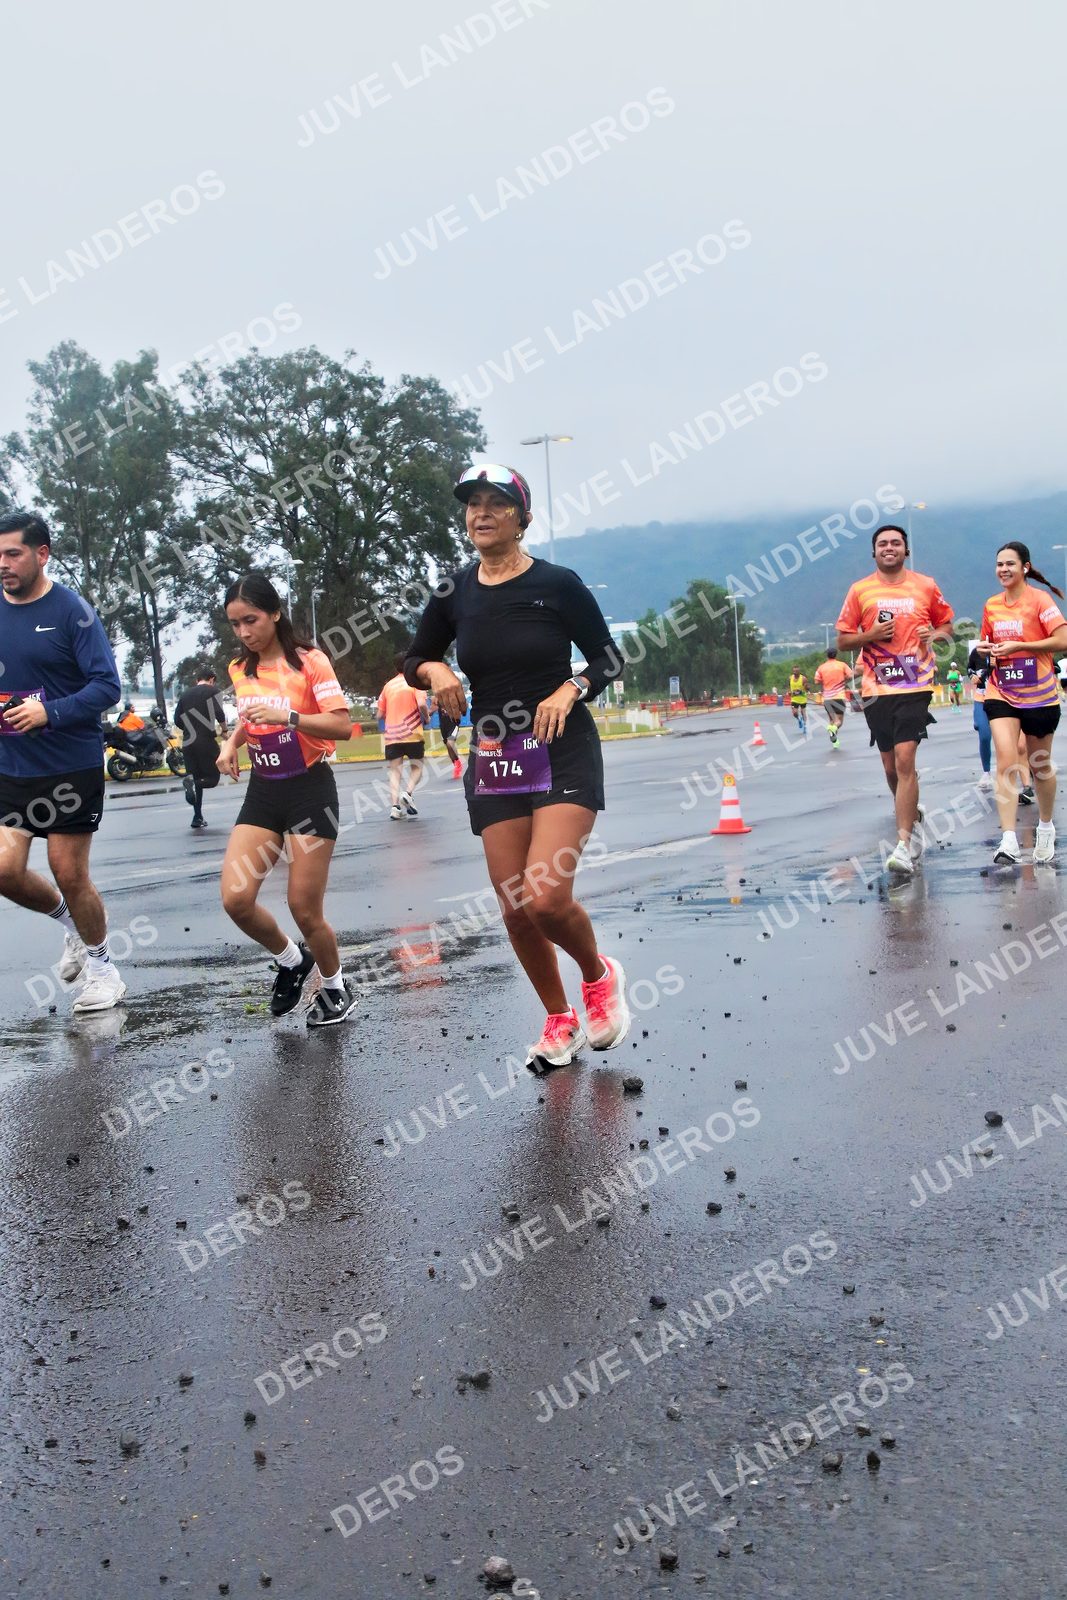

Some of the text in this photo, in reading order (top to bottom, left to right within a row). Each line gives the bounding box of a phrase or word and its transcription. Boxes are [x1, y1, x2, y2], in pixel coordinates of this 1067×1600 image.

[905, 656, 914, 664] 15K
[885, 667, 905, 677] 344
[1005, 670, 1024, 680] 345
[278, 732, 292, 745] 15K
[523, 738, 539, 750] 15K
[255, 752, 281, 767] 418
[489, 761, 523, 777] 174
